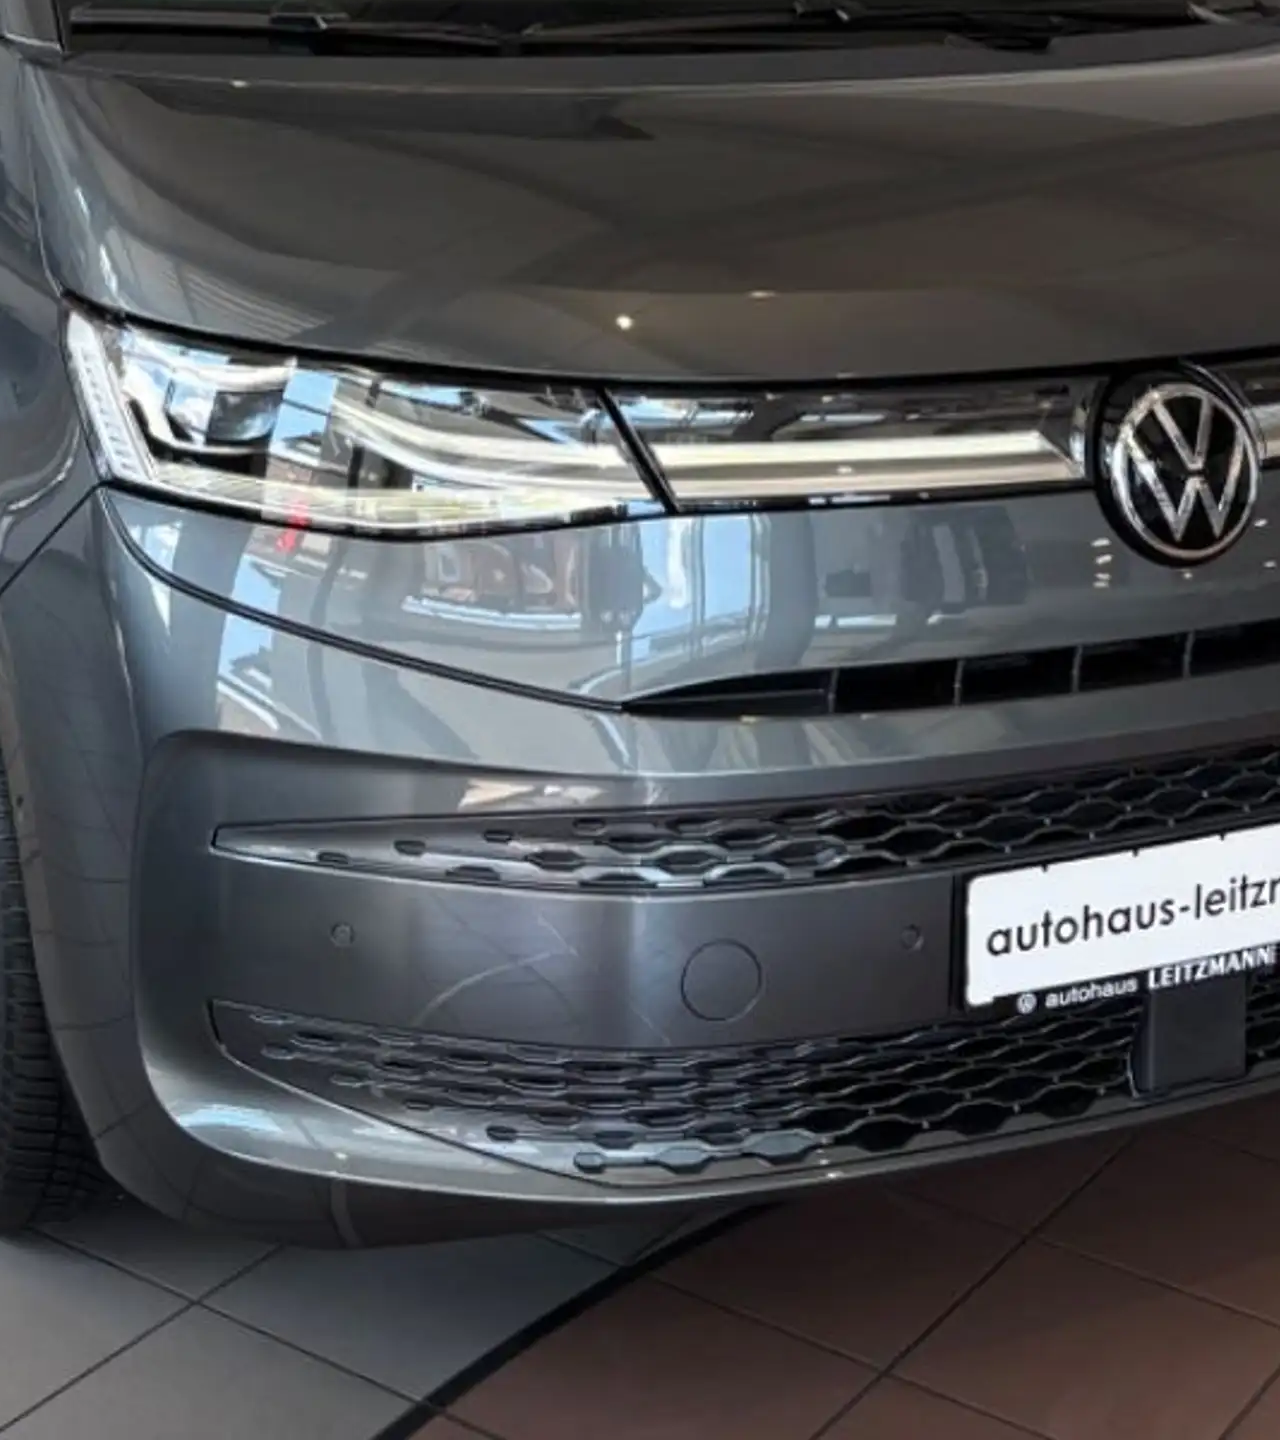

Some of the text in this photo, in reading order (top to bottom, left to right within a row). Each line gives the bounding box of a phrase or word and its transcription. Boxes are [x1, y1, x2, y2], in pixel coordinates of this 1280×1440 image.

[1116, 386, 1254, 555] VW
[1044, 977, 1139, 1009] autohaus
[1147, 945, 1277, 990] LEITZMANN
